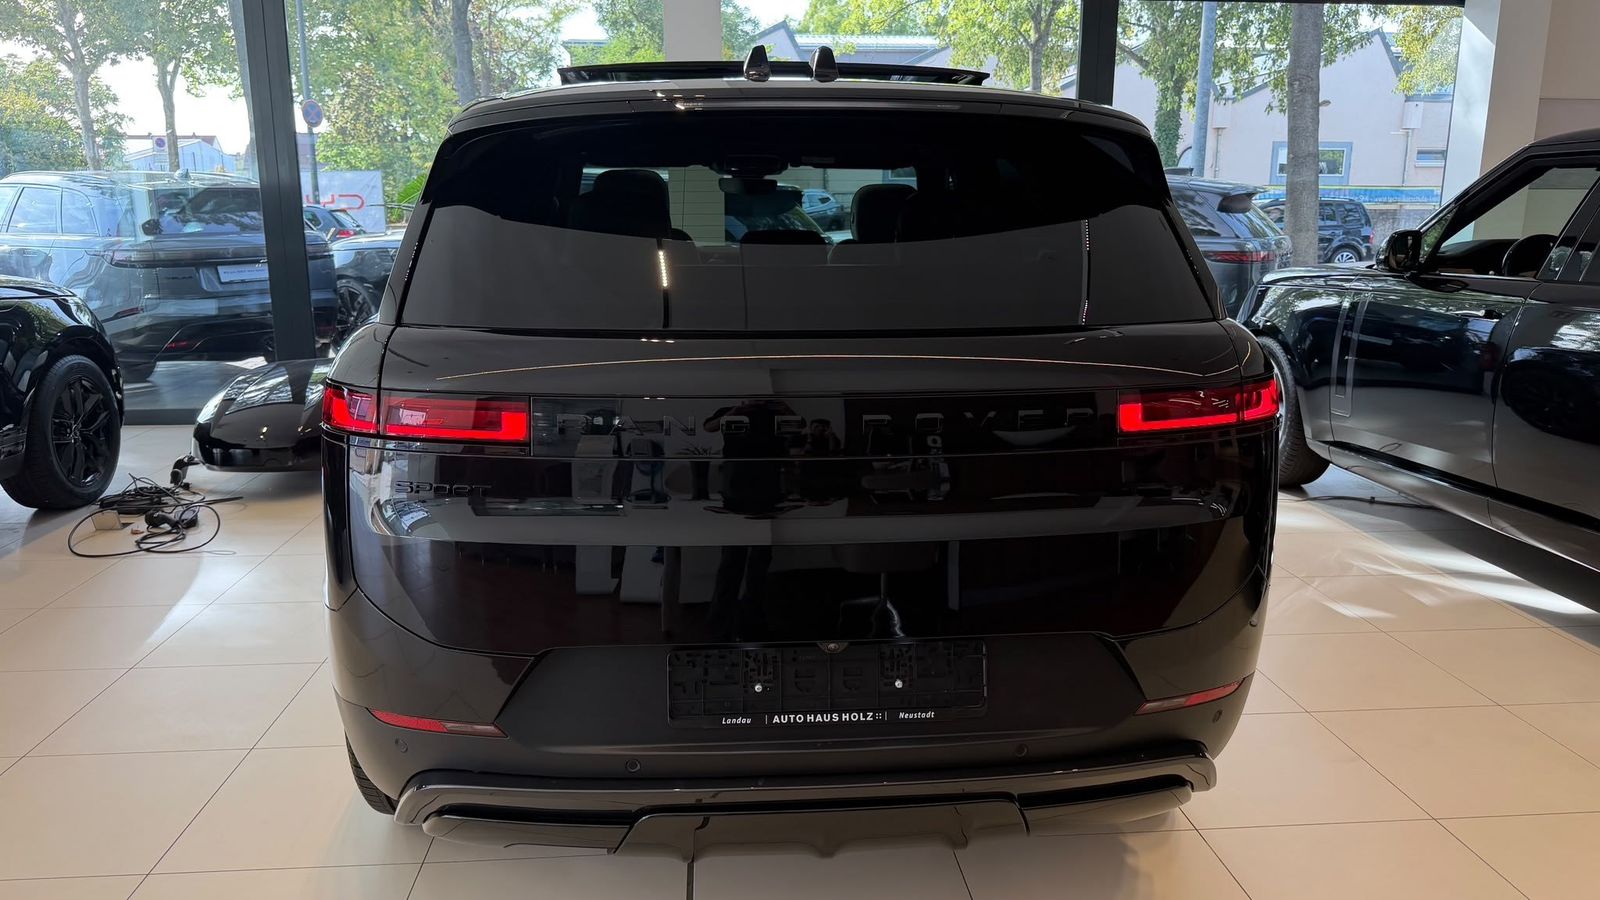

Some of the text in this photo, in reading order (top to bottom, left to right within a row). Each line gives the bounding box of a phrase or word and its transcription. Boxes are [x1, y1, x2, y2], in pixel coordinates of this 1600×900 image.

[557, 407, 1095, 436] RANGE ROVER
[395, 481, 492, 498] SPORT
[722, 716, 752, 724] Landau
[842, 712, 874, 721] HOLZ
[899, 711, 935, 719] Neustadt
